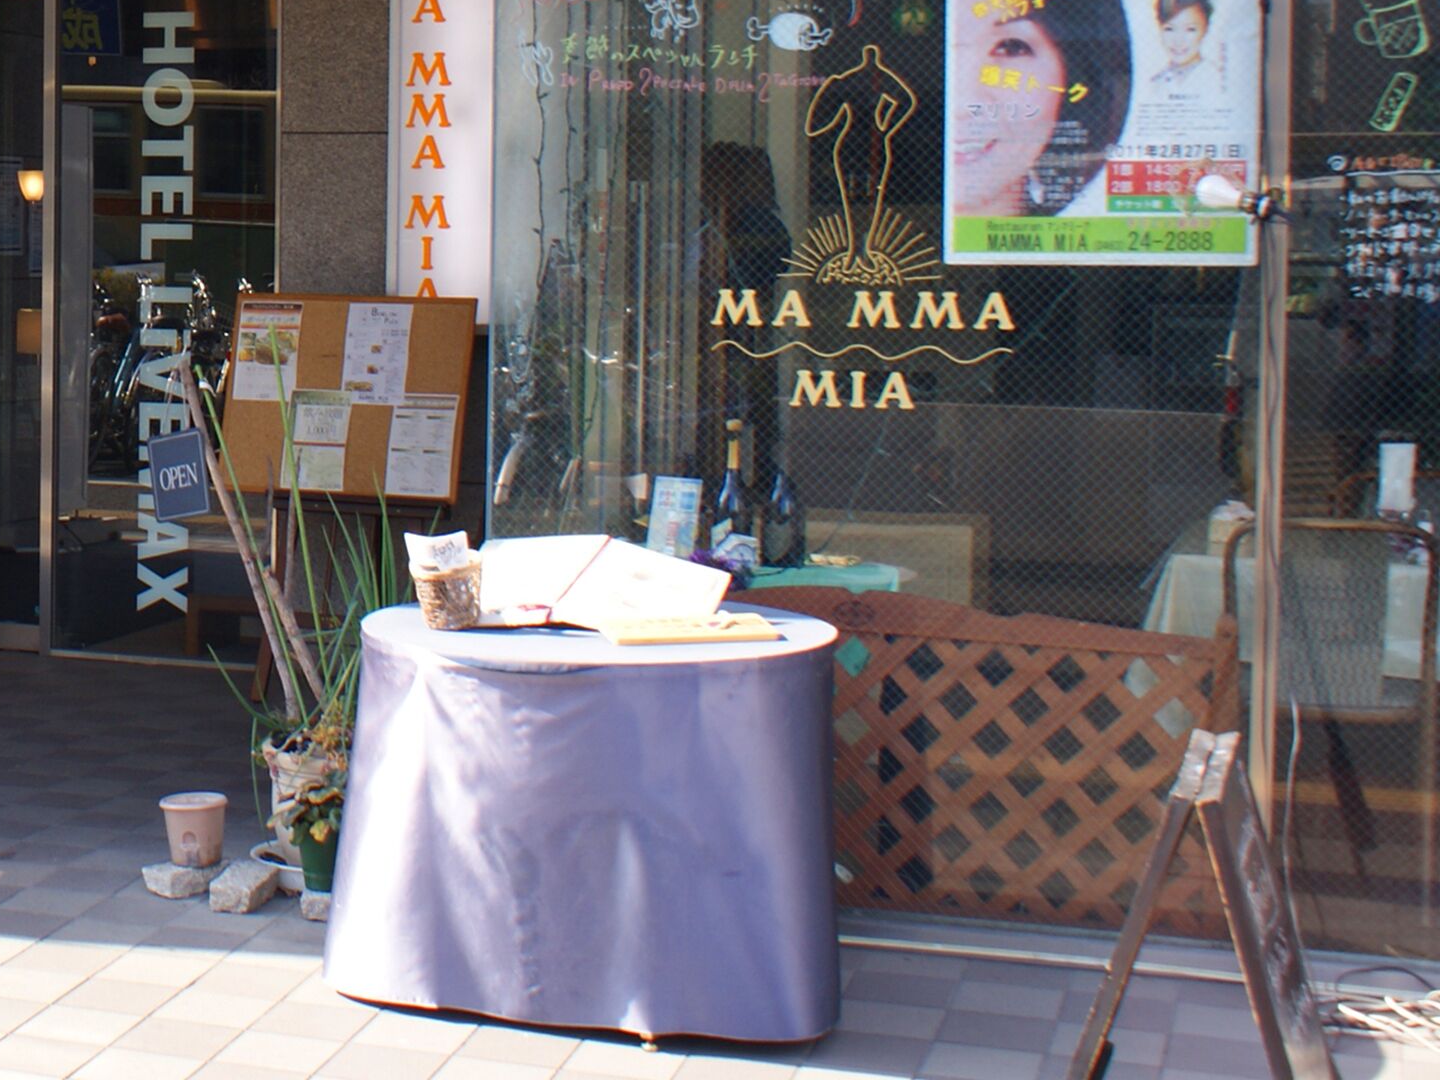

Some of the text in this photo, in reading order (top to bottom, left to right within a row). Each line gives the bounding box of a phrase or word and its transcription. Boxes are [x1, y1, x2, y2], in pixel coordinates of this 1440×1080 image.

[967, 103, 1040, 120] マリリン
[140, 10, 195, 261] HOTEL
[987, 233, 1042, 251] MAMMA
[1053, 233, 1088, 251] MIA
[1127, 230, 1214, 252] 24-2888
[788, 369, 915, 410] MIA
[159, 461, 199, 491] OPEN
